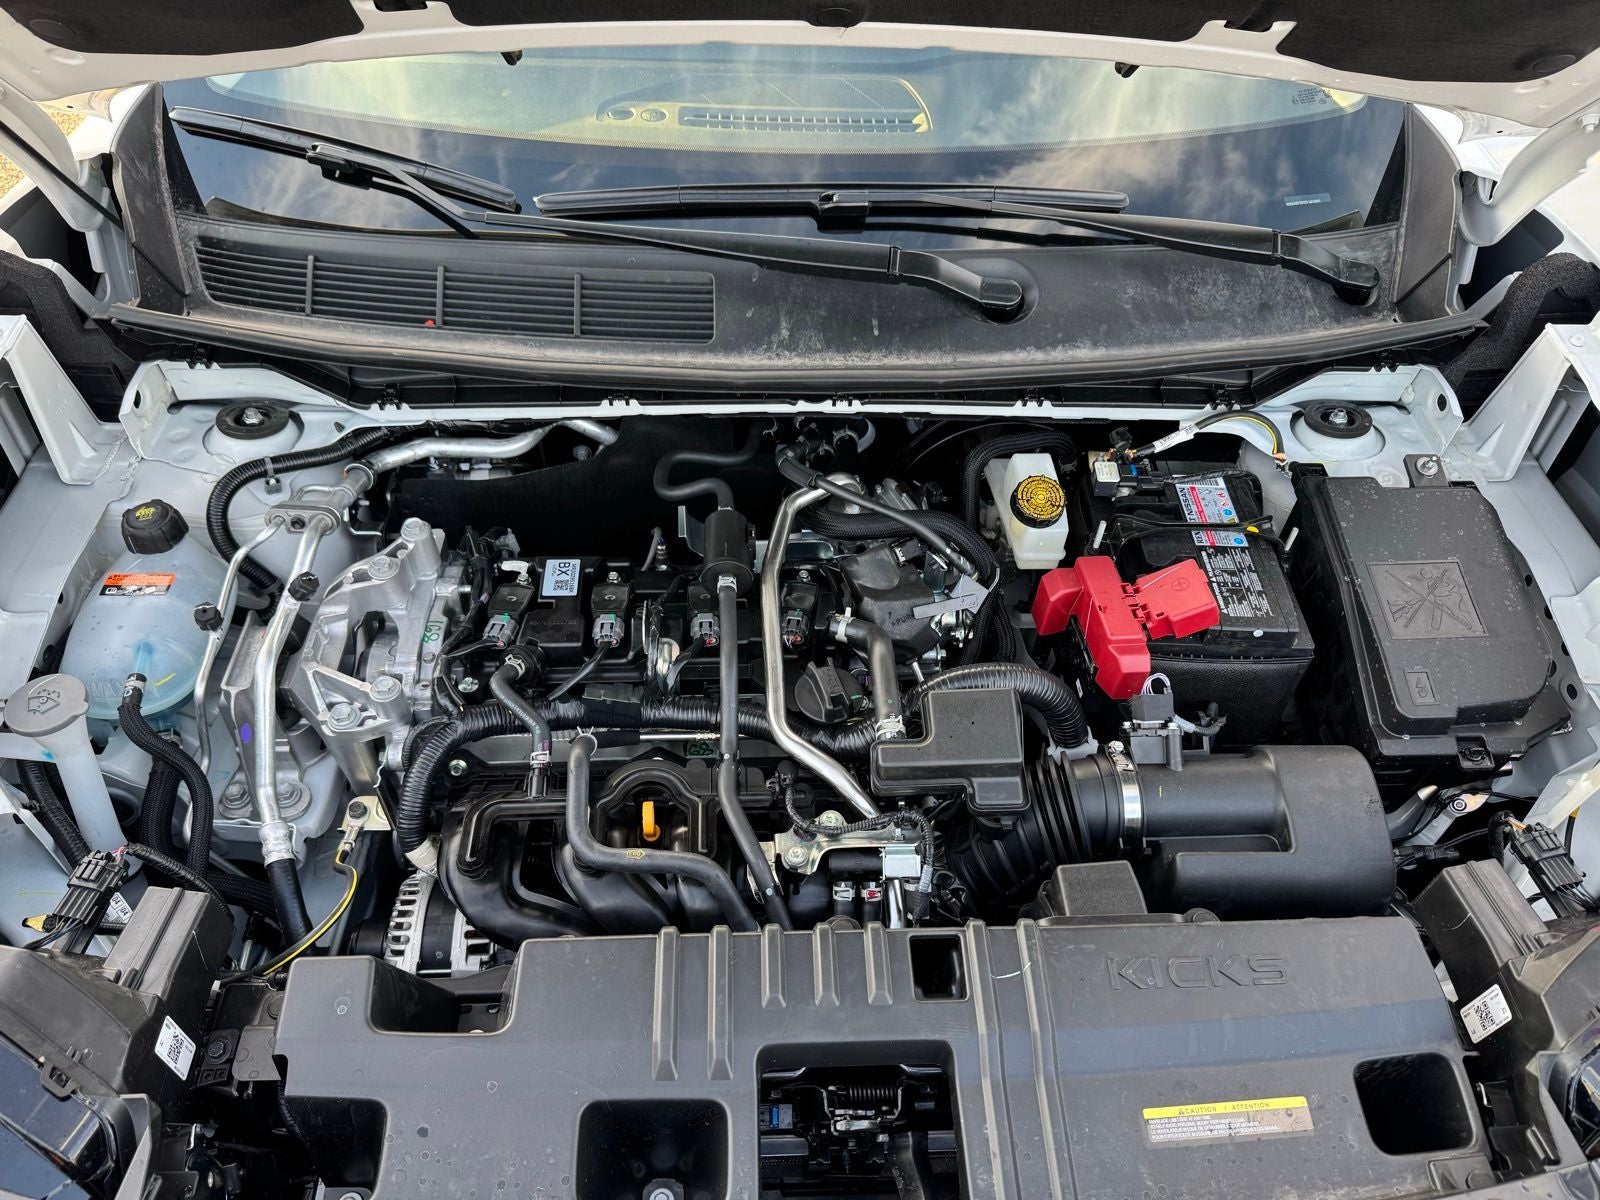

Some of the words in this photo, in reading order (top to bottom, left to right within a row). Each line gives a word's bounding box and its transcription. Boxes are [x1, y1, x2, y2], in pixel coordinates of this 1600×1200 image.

[1178, 487, 1194, 517] NISSAN
[558, 562, 570, 576] BX
[422, 620, 444, 643] 168
[1106, 952, 1287, 991] KICKS
[1186, 1106, 1217, 1115] CAUTION
[1232, 1102, 1270, 1111] ATTENTION
